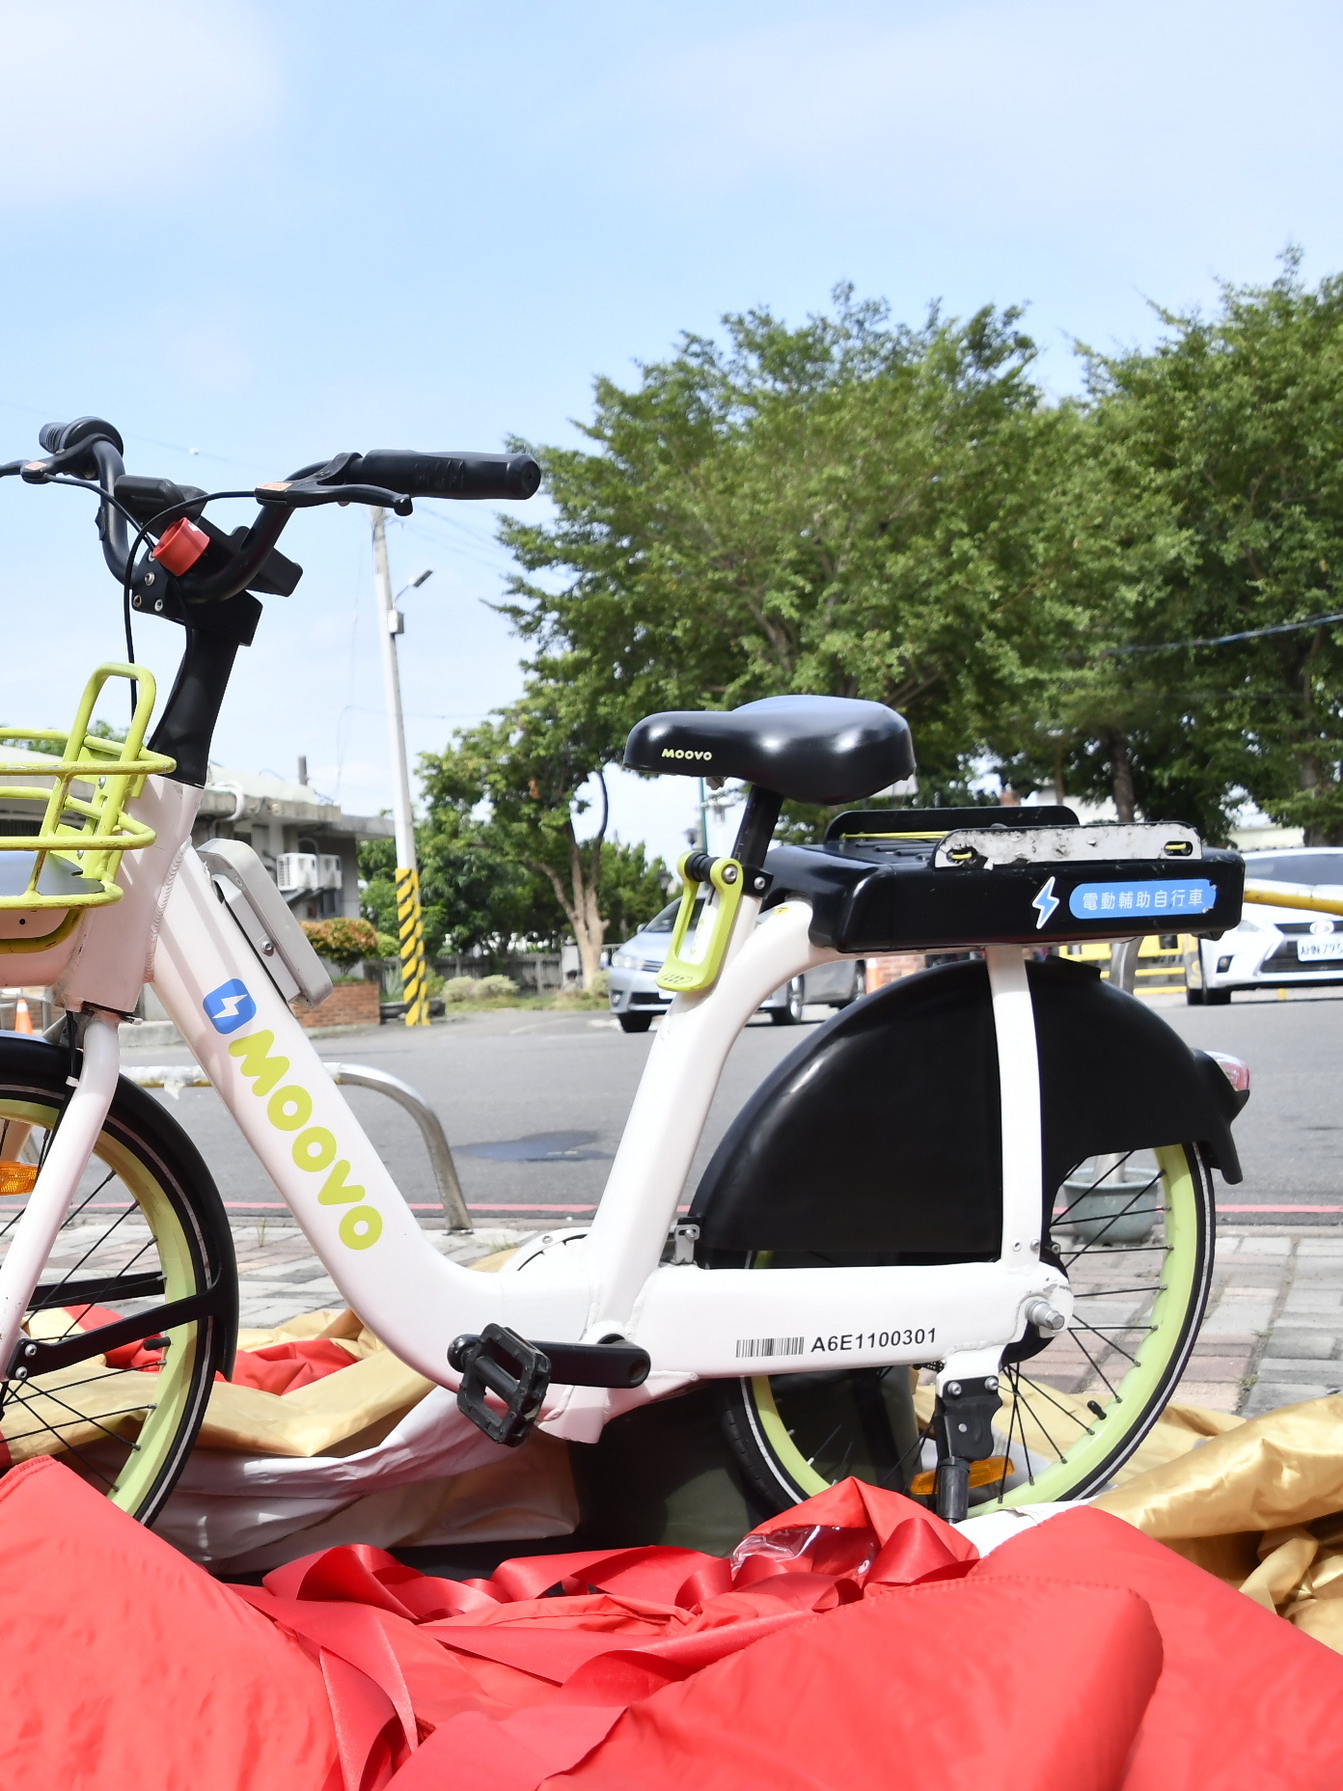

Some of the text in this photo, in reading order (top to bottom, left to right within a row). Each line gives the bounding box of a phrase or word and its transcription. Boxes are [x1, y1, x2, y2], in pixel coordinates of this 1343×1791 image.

[661, 748, 713, 761] MOOVO
[1082, 888, 1204, 911] 電動輔助自行車
[228, 1030, 383, 1250] MOOVO
[810, 1327, 936, 1353] A6E1100301
